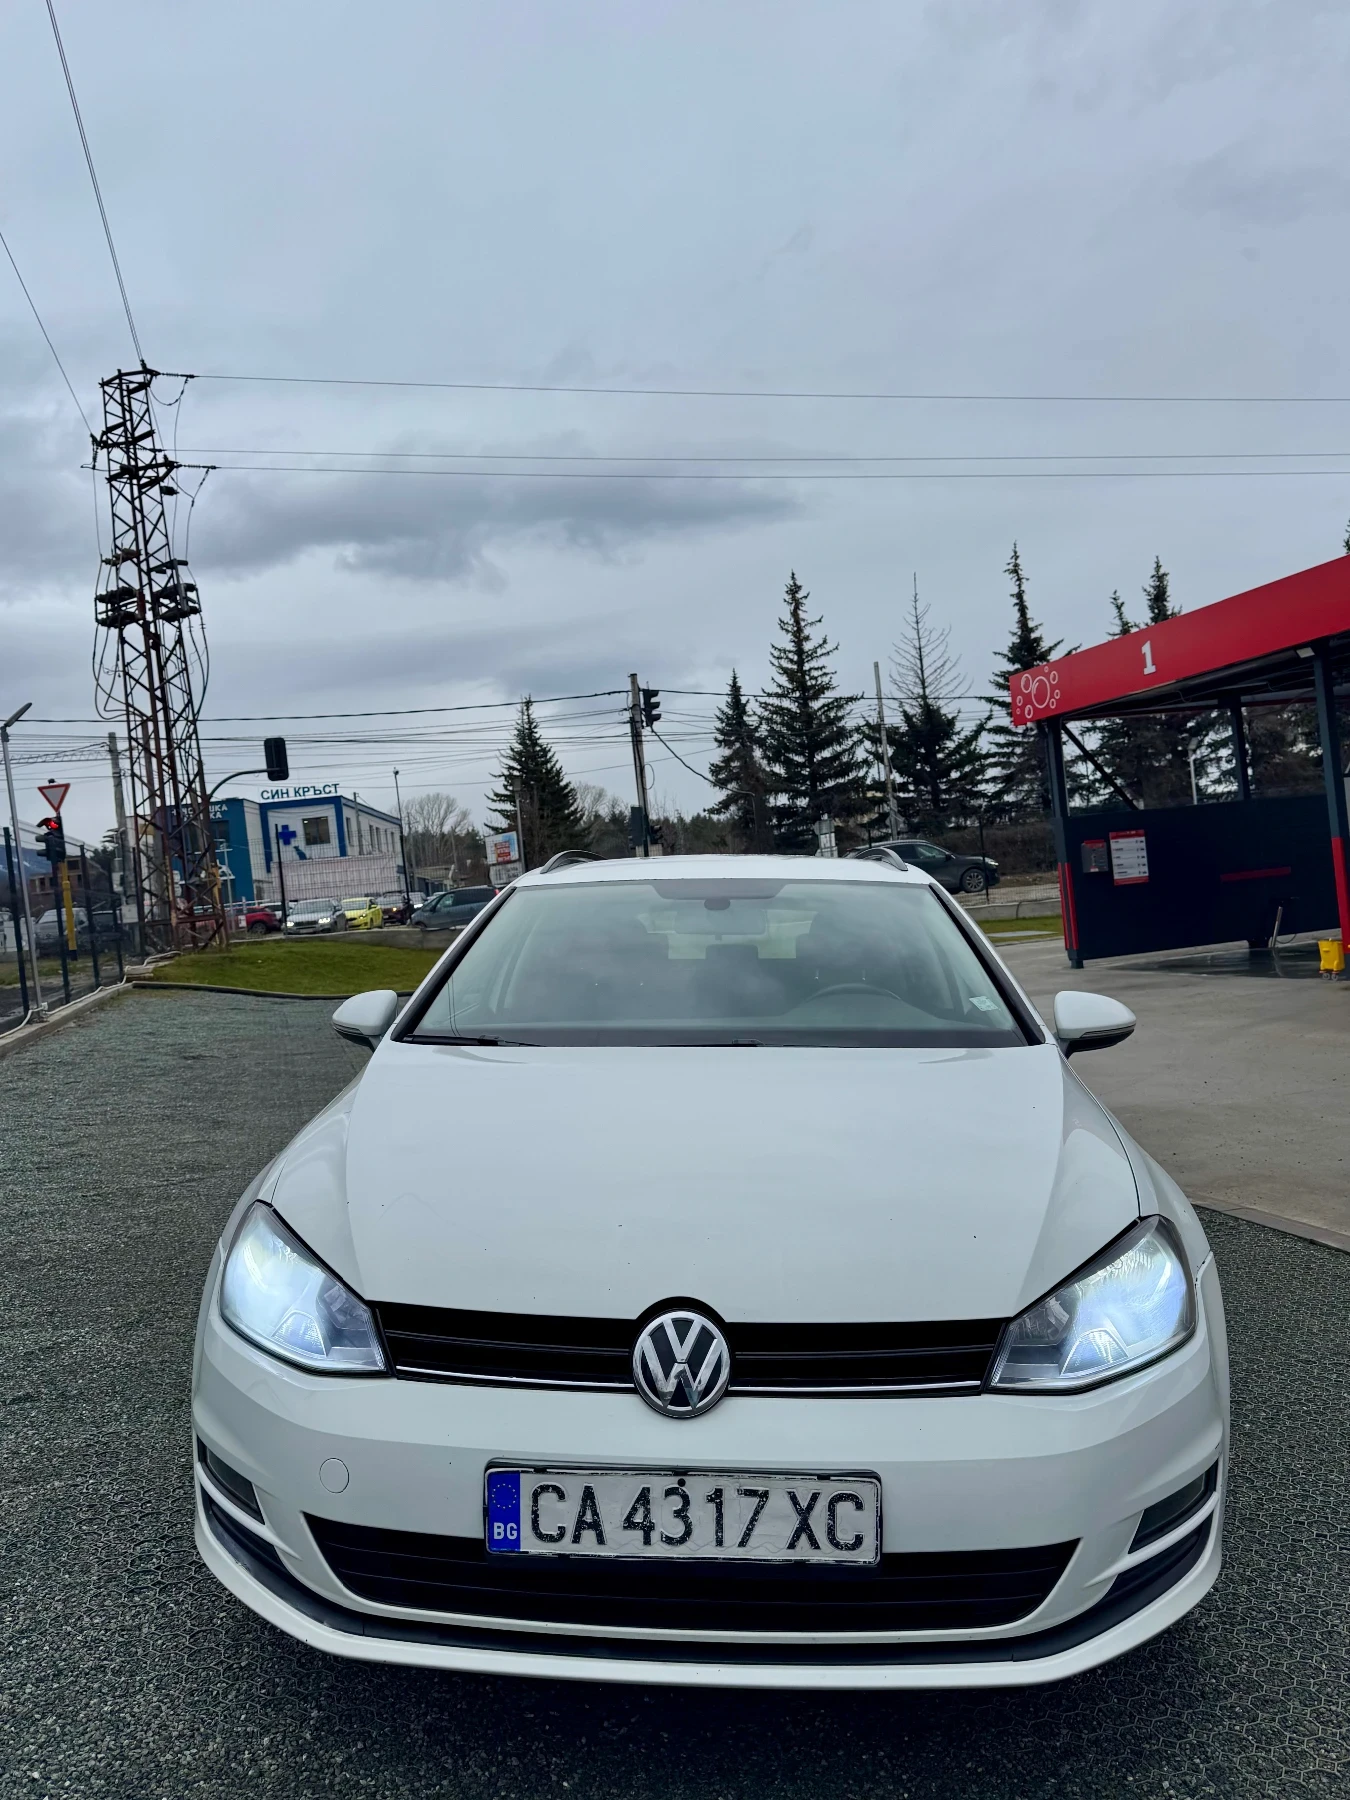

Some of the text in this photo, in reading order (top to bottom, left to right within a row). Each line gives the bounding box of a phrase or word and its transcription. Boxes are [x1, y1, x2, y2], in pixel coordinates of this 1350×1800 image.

[1141, 640, 1157, 675] 1
[260, 783, 340, 800] СИН КРЪСТ
[633, 1311, 730, 1417] VW
[493, 1522, 518, 1540] BG
[531, 1483, 864, 1552] CA 4317 XC
